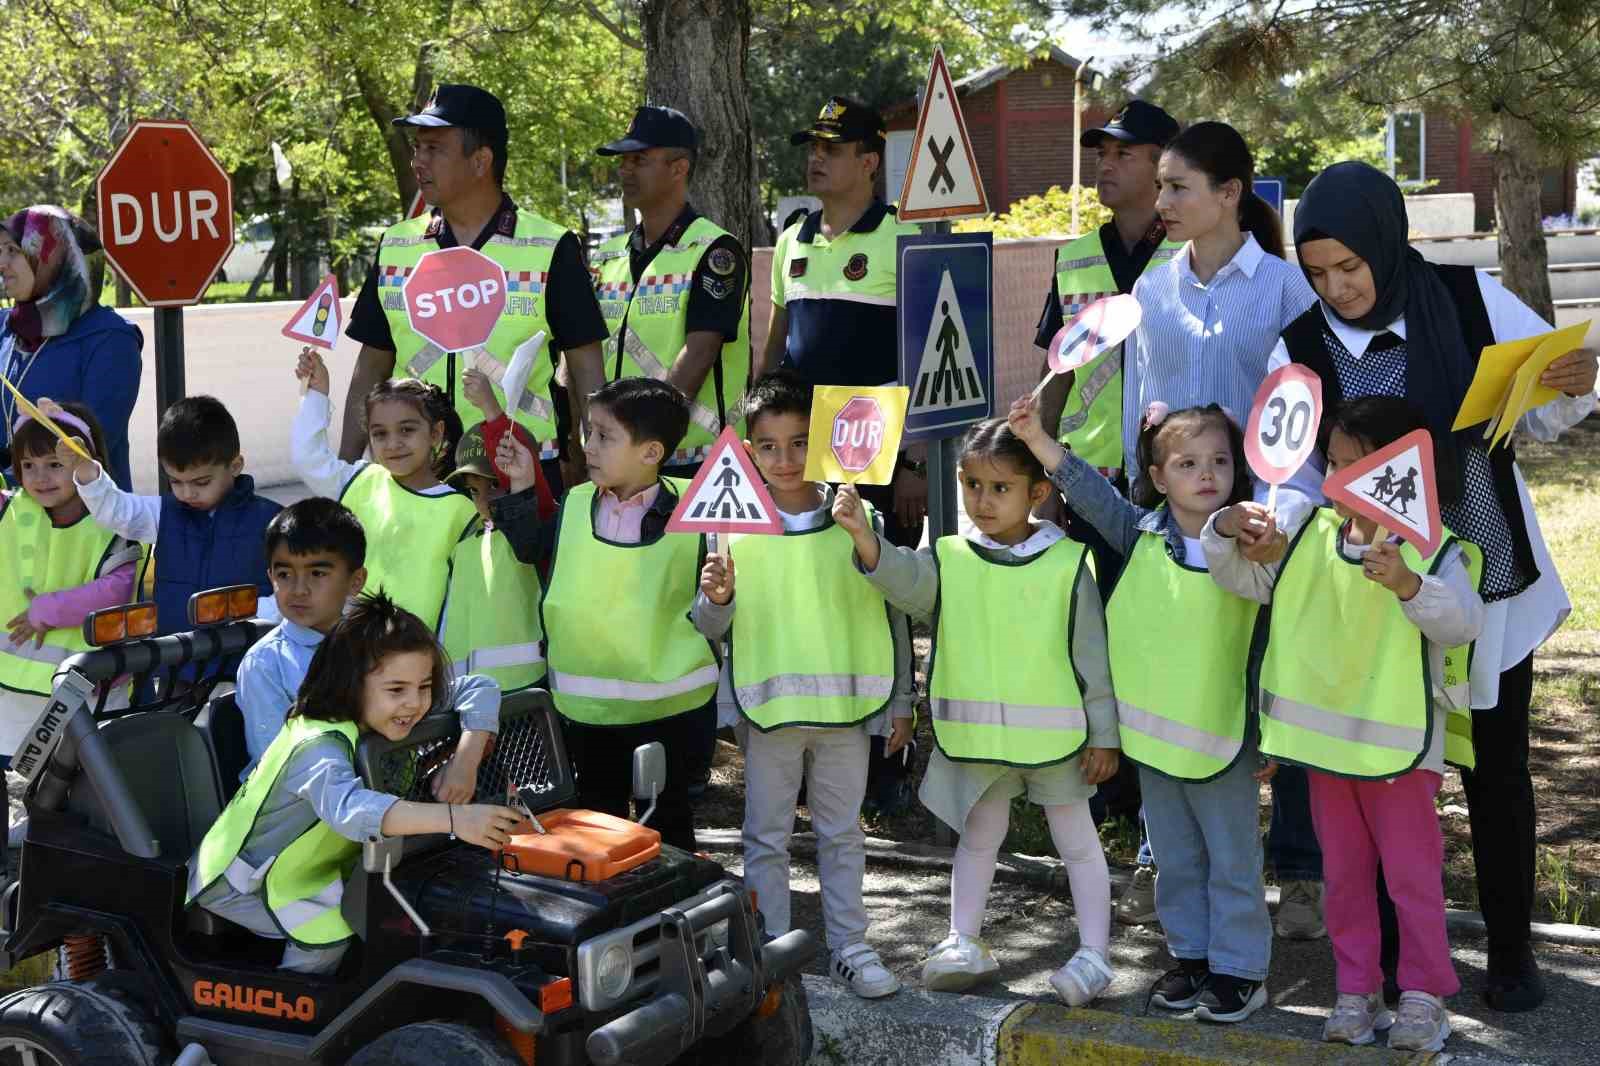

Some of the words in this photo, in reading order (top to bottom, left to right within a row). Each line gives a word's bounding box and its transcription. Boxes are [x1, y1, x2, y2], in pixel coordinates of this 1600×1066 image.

[110, 189, 220, 246] DUR
[415, 279, 499, 318] STOP
[833, 418, 881, 449] DUR
[1260, 396, 1312, 452] 30
[35, 700, 69, 745] PEG
